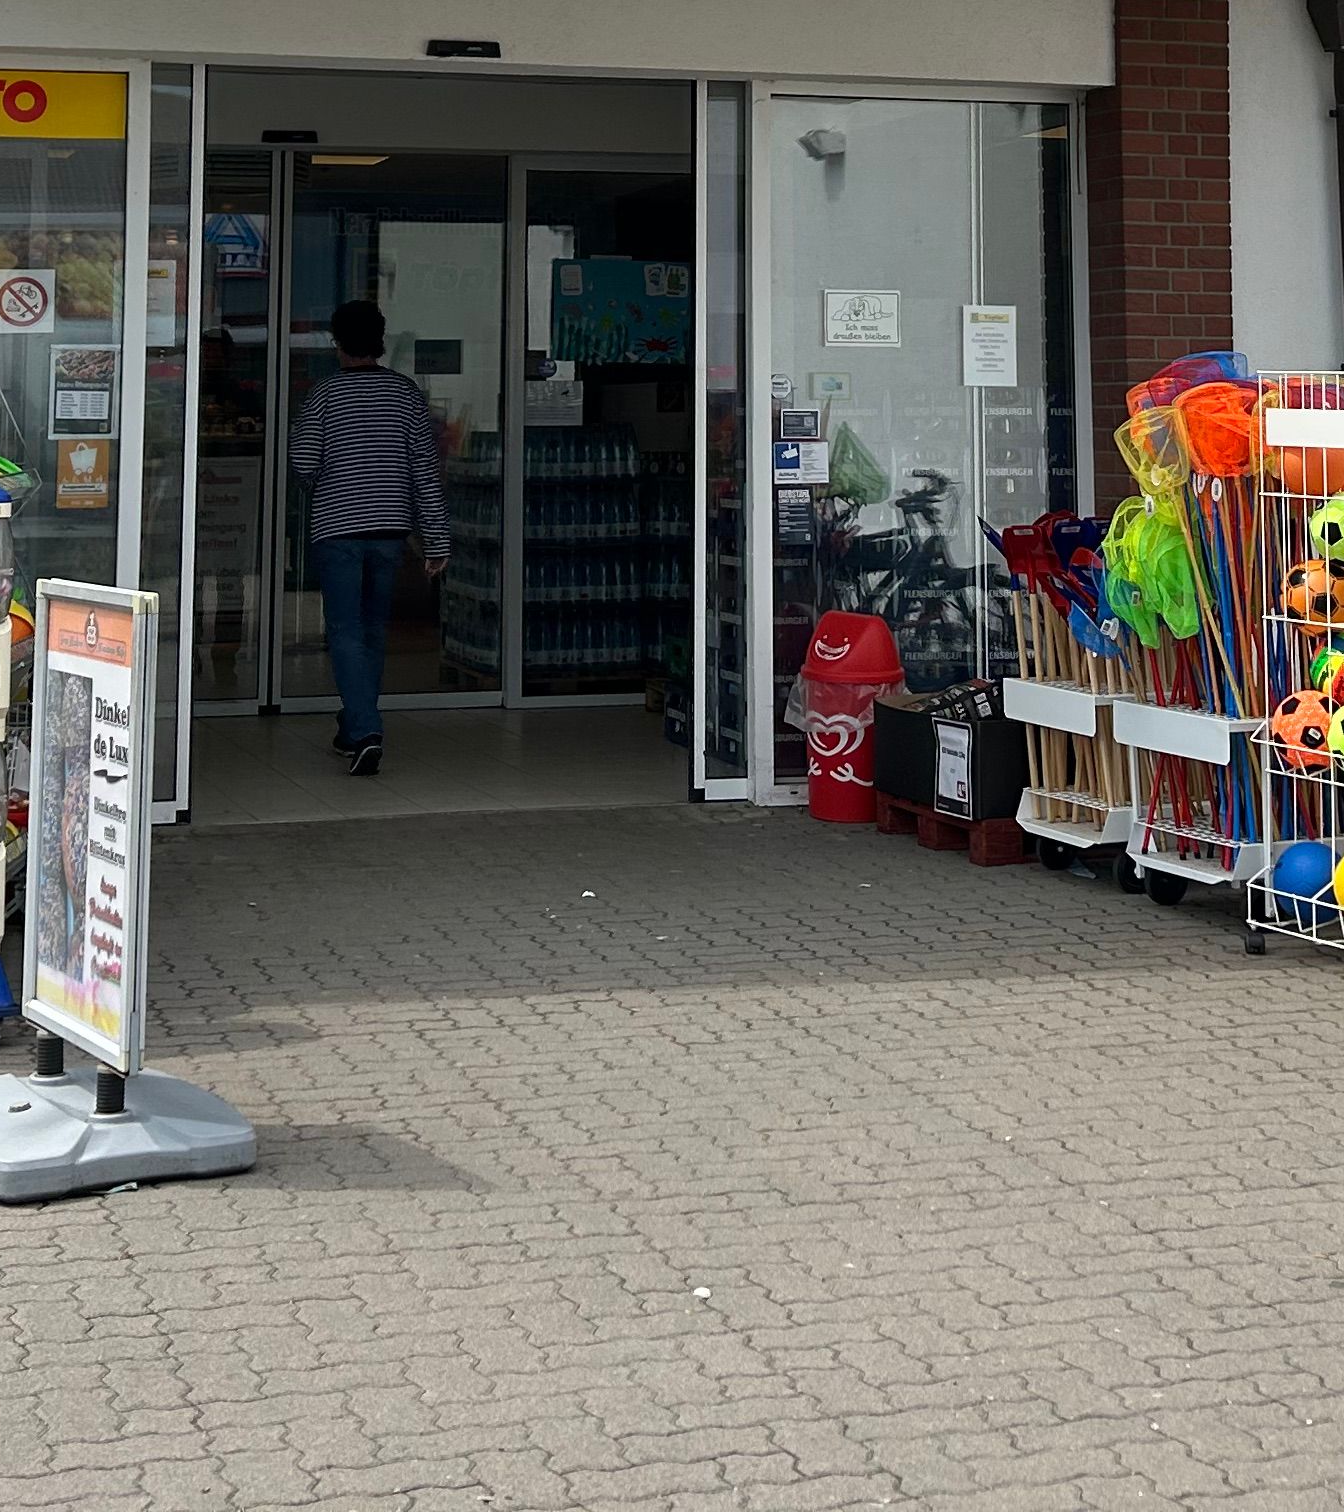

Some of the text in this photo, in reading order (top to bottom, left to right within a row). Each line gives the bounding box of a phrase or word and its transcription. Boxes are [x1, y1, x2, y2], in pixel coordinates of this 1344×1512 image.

[984, 407, 1033, 416] ENSBURGER
[985, 467, 1034, 476] ENSBURGER
[94, 696, 131, 727] Dinkel
[94, 733, 129, 764] de Lux
[93, 796, 127, 821] Dinkelbro
